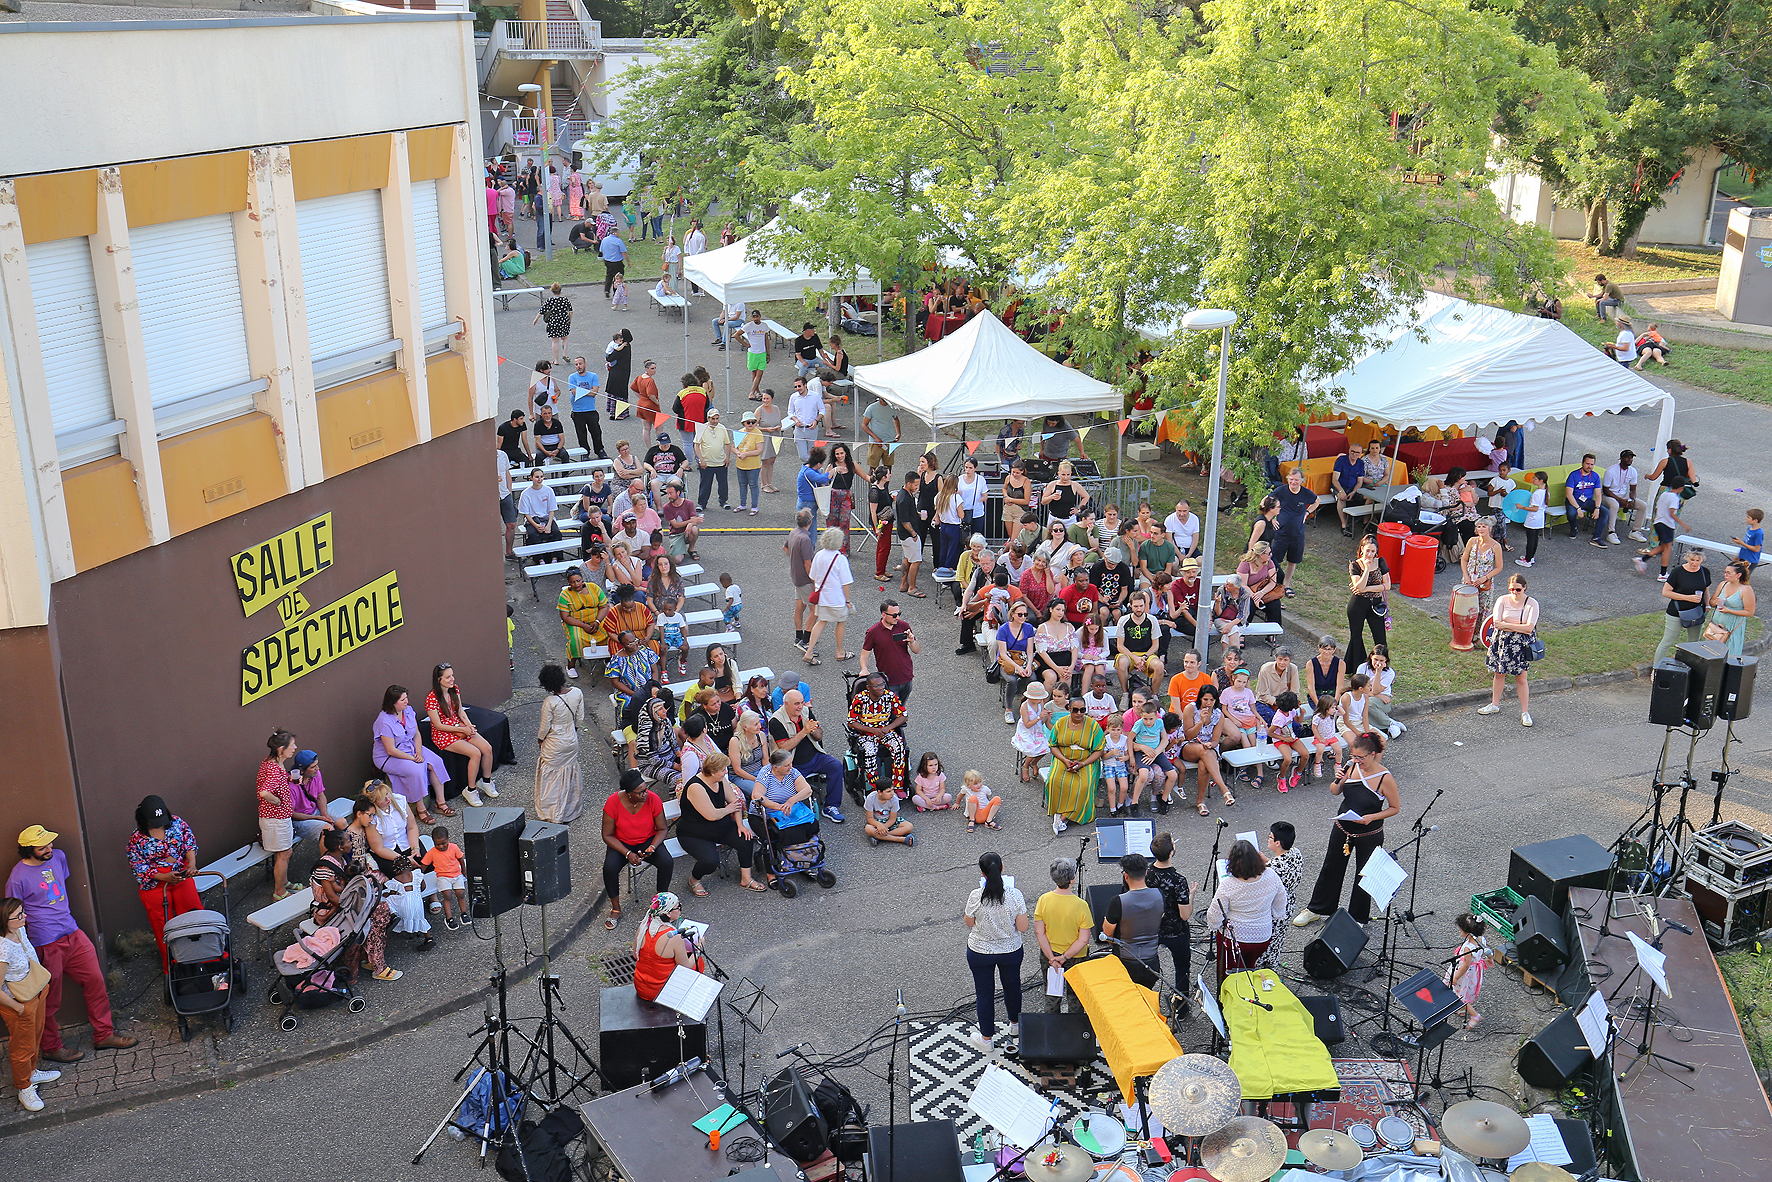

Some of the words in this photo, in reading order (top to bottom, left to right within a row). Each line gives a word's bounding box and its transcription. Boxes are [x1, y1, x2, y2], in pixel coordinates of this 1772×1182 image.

[236, 520, 331, 602] SALLE
[283, 590, 303, 621] DE
[242, 581, 403, 695] SPECTACLE
[523, 850, 529, 858] 3
